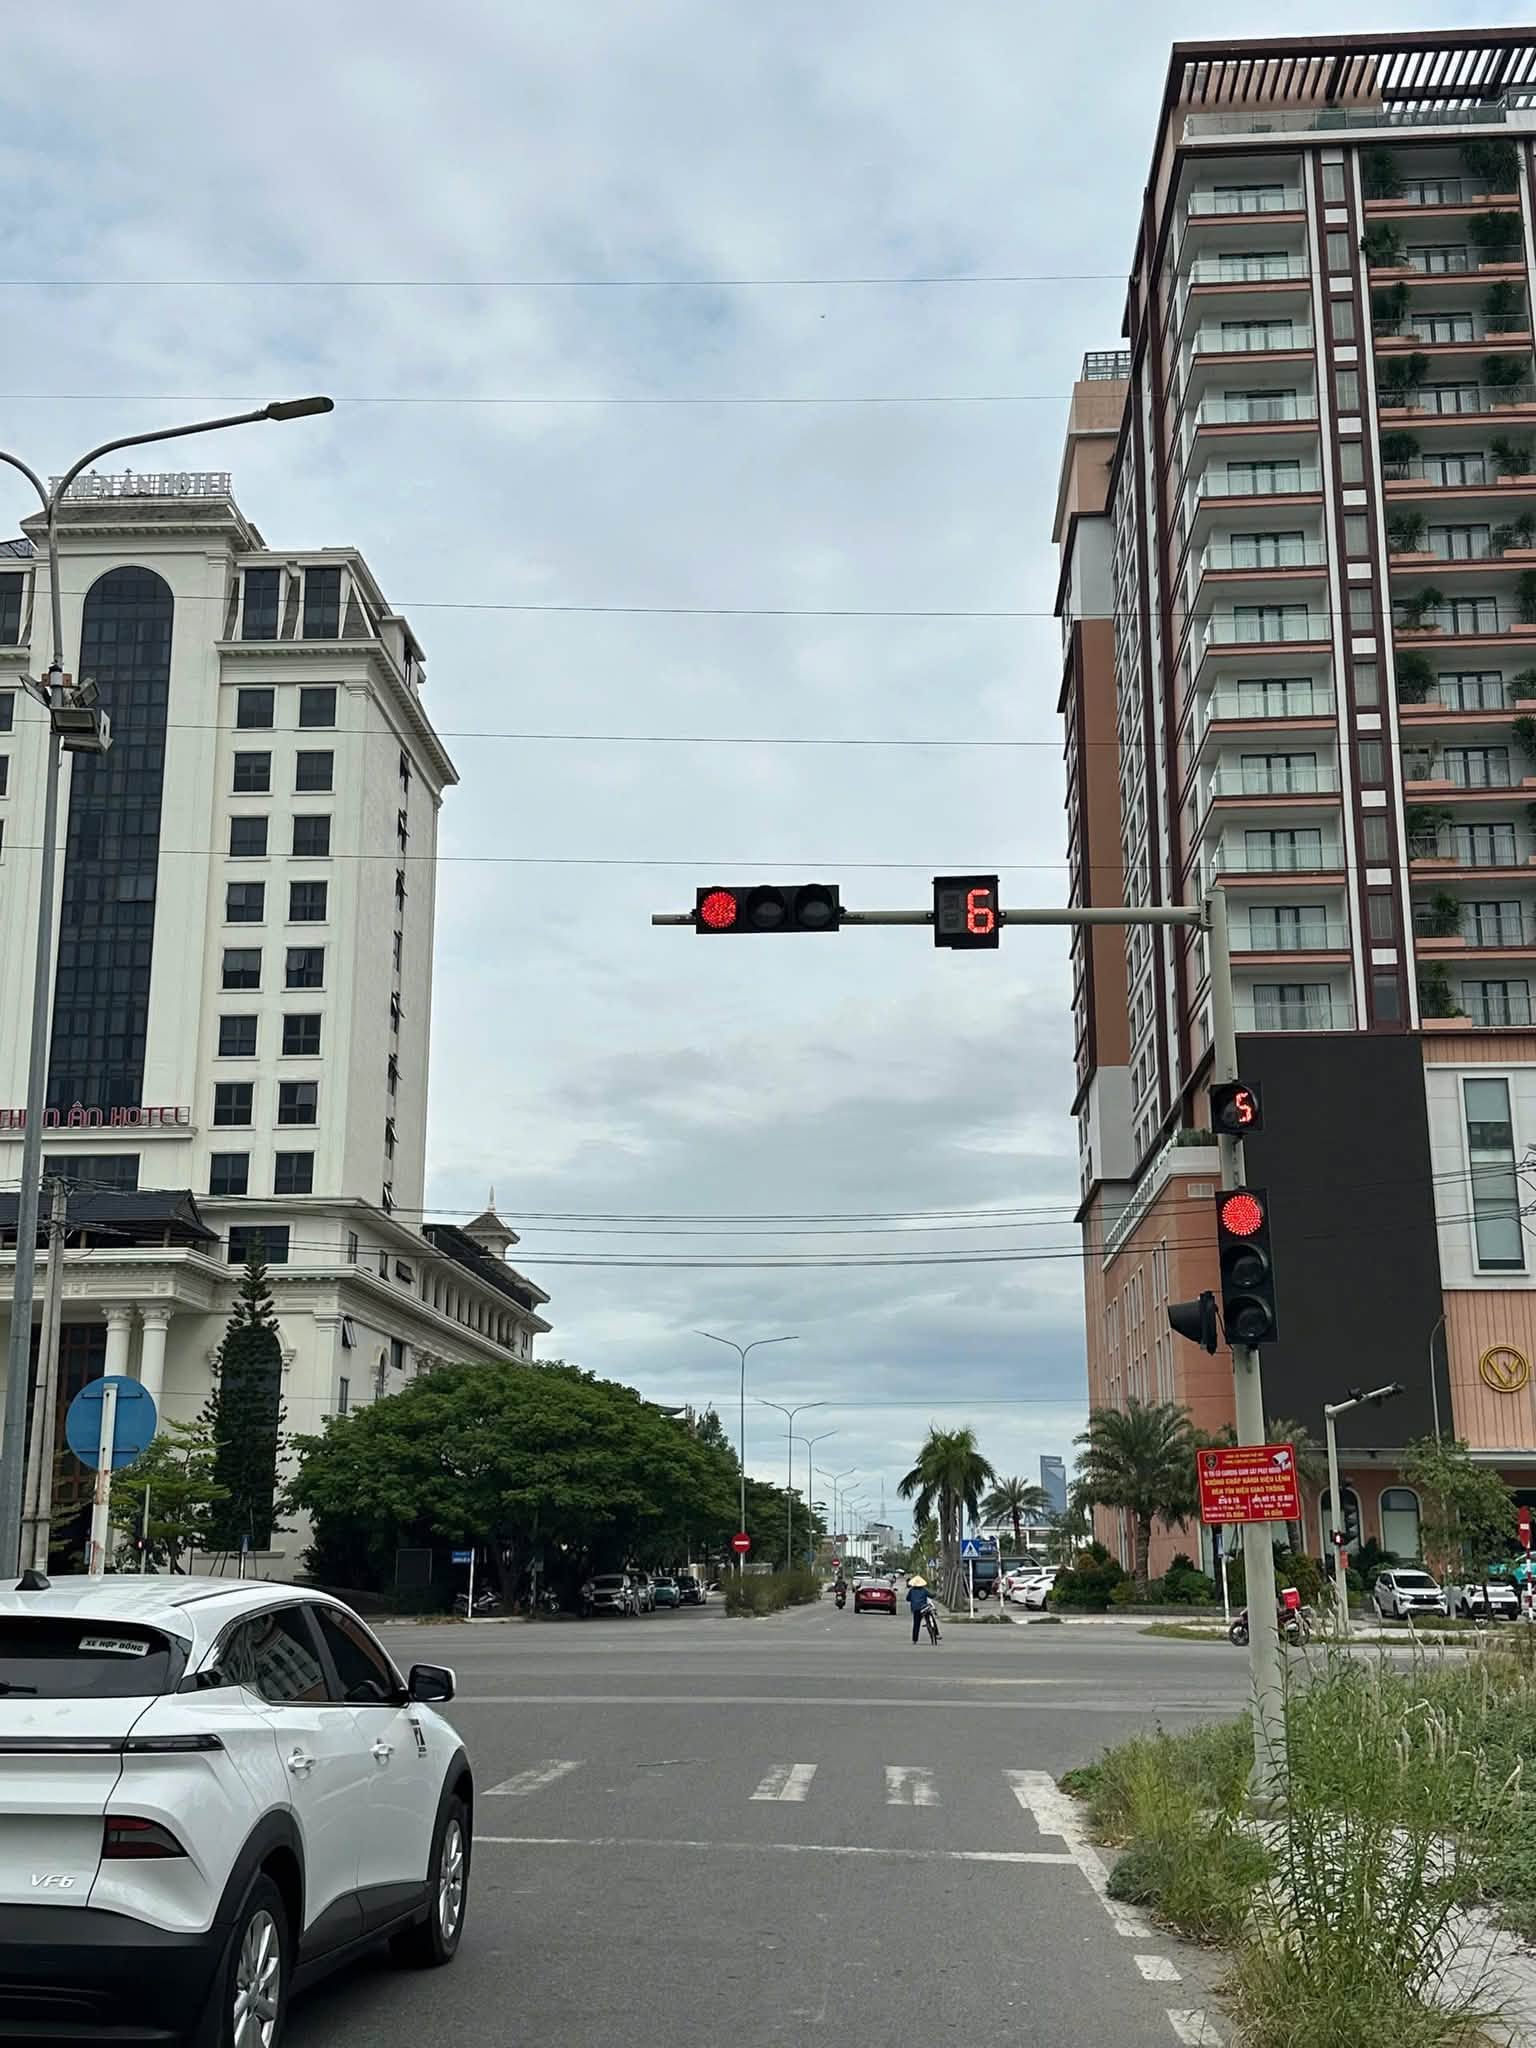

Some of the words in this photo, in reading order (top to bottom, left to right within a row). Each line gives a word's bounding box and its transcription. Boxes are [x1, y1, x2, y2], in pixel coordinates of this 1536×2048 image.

[160, 472, 231, 495] HOTEL
[967, 888, 995, 934] 6
[110, 1105, 191, 1128] HOTEL
[1236, 1092, 1252, 1122] 5
[85, 1639, 97, 1648] XE
[31, 1872, 77, 1889] VF6
